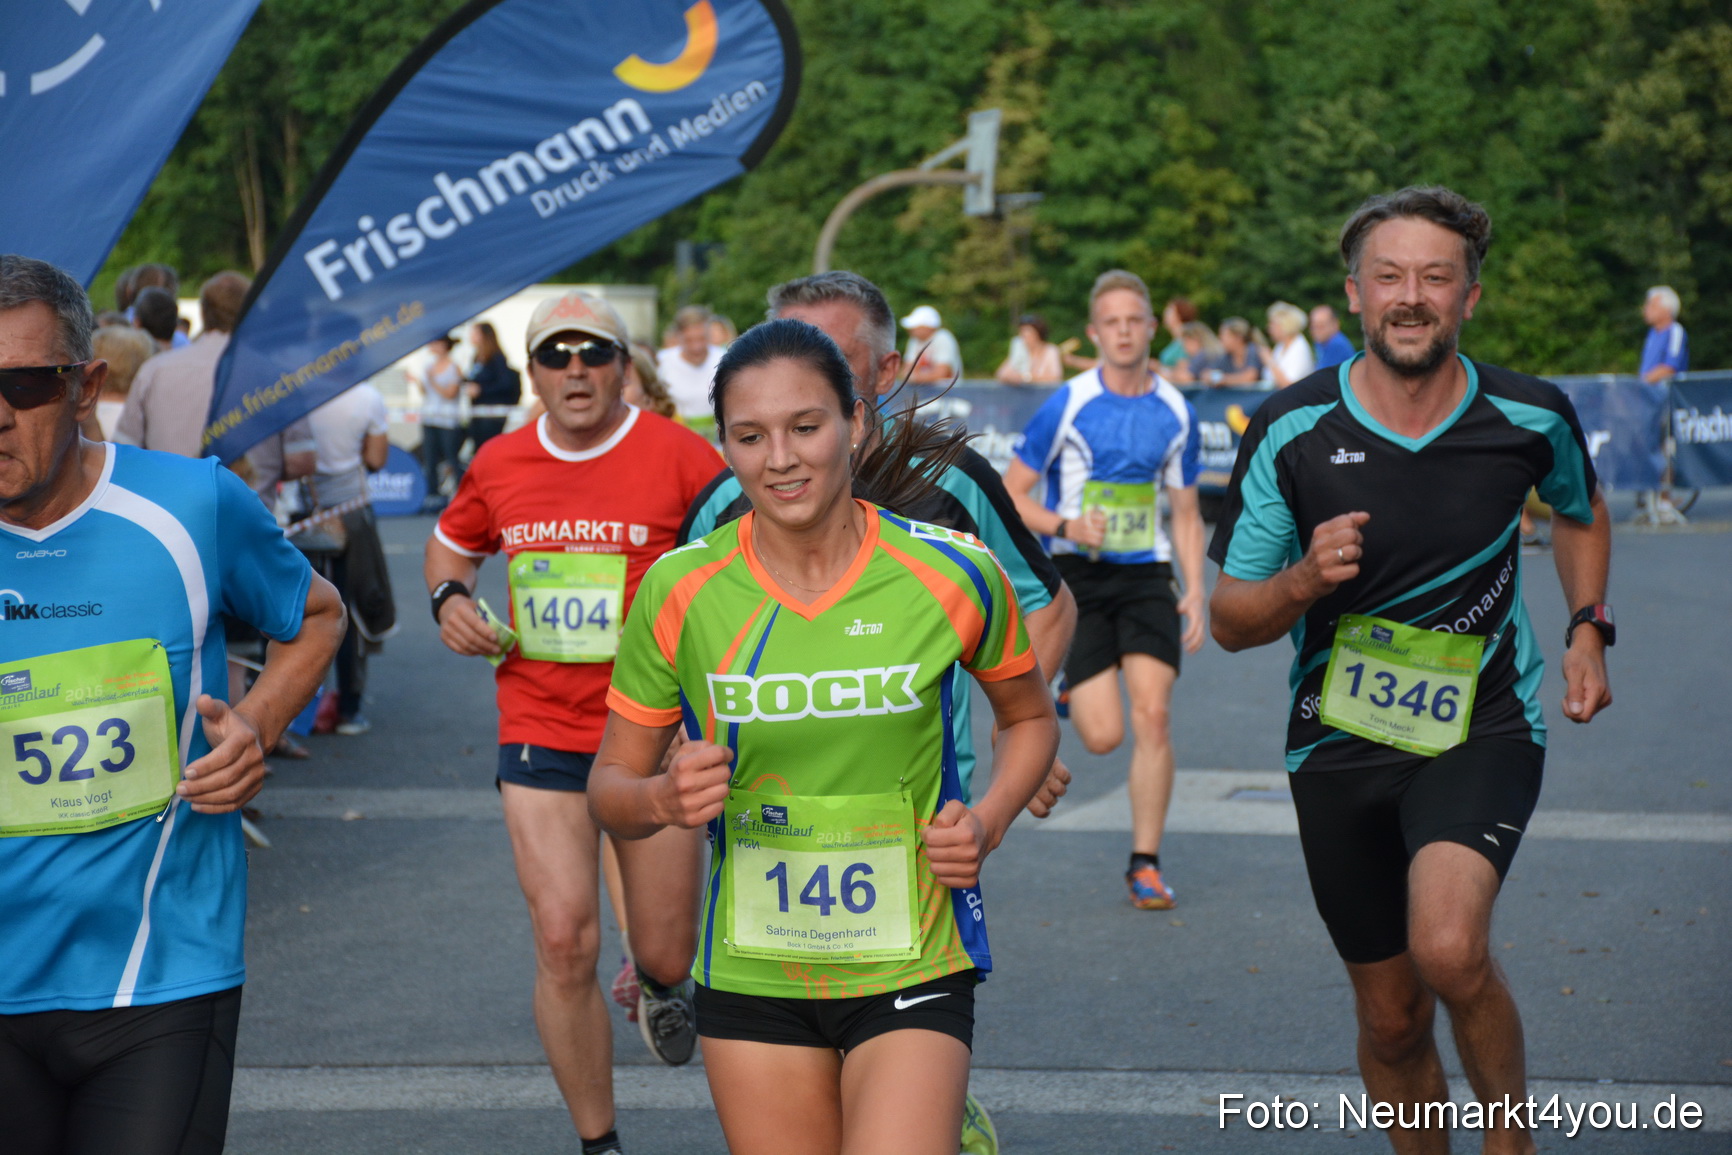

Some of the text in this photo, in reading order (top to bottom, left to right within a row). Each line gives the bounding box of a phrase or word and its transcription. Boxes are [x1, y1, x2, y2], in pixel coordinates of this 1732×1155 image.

[531, 80, 768, 219] Druck und Medien
[304, 98, 652, 300] Frischmann
[501, 519, 624, 547] NEUMARKT
[40, 601, 103, 619] classic
[523, 597, 610, 631] 1404
[65, 685, 103, 702] 2016
[706, 663, 924, 723] BOCK
[1345, 662, 1460, 722] 1346
[1369, 714, 1388, 728] Tom
[13, 717, 136, 786] 523
[51, 790, 113, 808] Klaus Vogt
[752, 820, 814, 837] firmenlauf
[816, 832, 852, 844] 2016
[765, 861, 877, 916] 146
[766, 925, 877, 942] Sabrina Degenhardt
